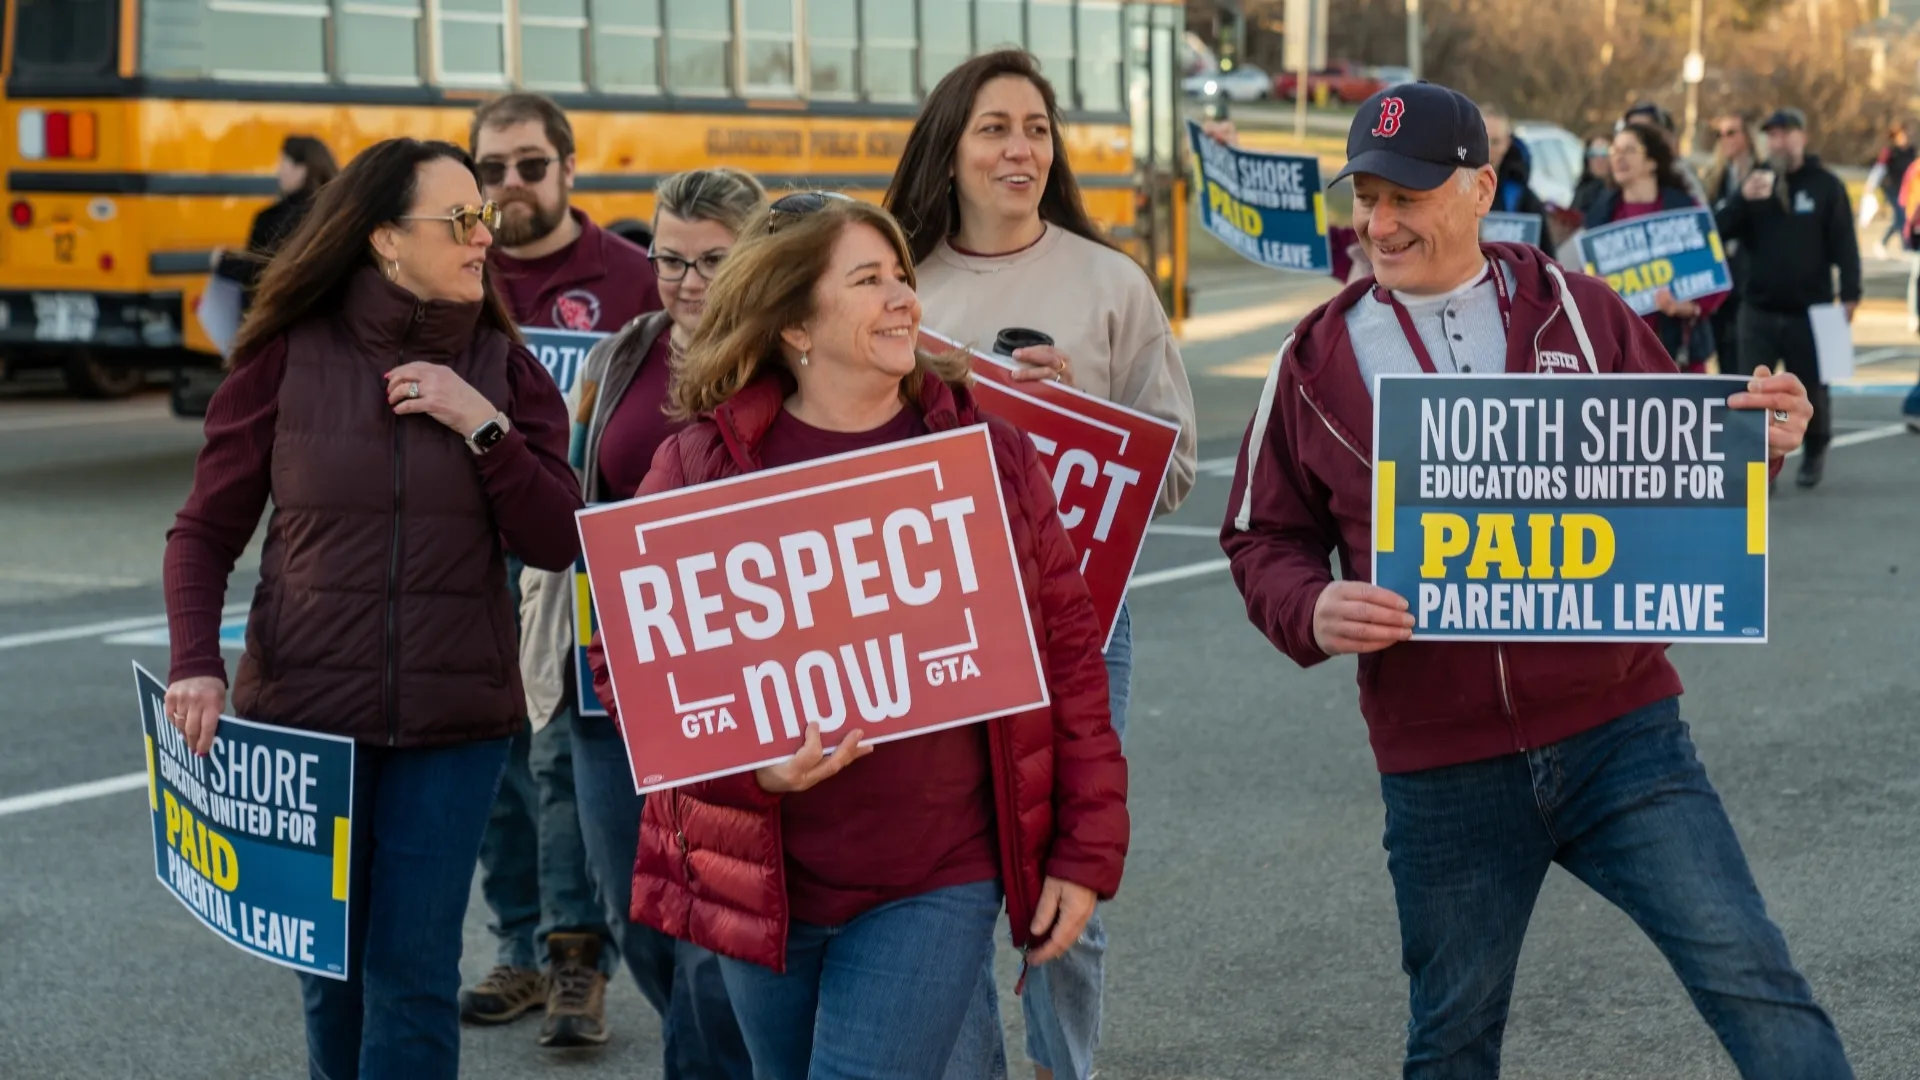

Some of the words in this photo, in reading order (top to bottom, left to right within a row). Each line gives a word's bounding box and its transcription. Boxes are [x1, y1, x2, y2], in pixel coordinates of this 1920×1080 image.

[1372, 97, 1405, 137] B
[1238, 156, 1306, 194] SHORE
[1208, 180, 1263, 238] PAID
[1262, 239, 1314, 268] LEAVE
[1606, 258, 1674, 296] PAID
[1420, 397, 1564, 462] NORTH
[1581, 397, 1725, 463] SHORE
[1027, 432, 1141, 543] CT
[1420, 465, 1567, 499] EDUCATORS
[1575, 465, 1666, 500] UNITED
[1675, 465, 1724, 500] FOR
[1420, 513, 1616, 579] PAID
[620, 496, 979, 664] RESPECT
[1419, 583, 1602, 631] PARENTAL
[1614, 583, 1724, 631] LEAVE
[925, 654, 981, 687] GTA
[681, 707, 738, 739] GTA
[158, 747, 208, 815] EDUCATORS
[210, 793, 271, 837] UNITED
[277, 811, 316, 847] FOR
[210, 736, 319, 813] SHORE
[163, 791, 238, 892] PAID
[167, 846, 237, 938] PARENTAL
[240, 902, 315, 963] LEAVE
